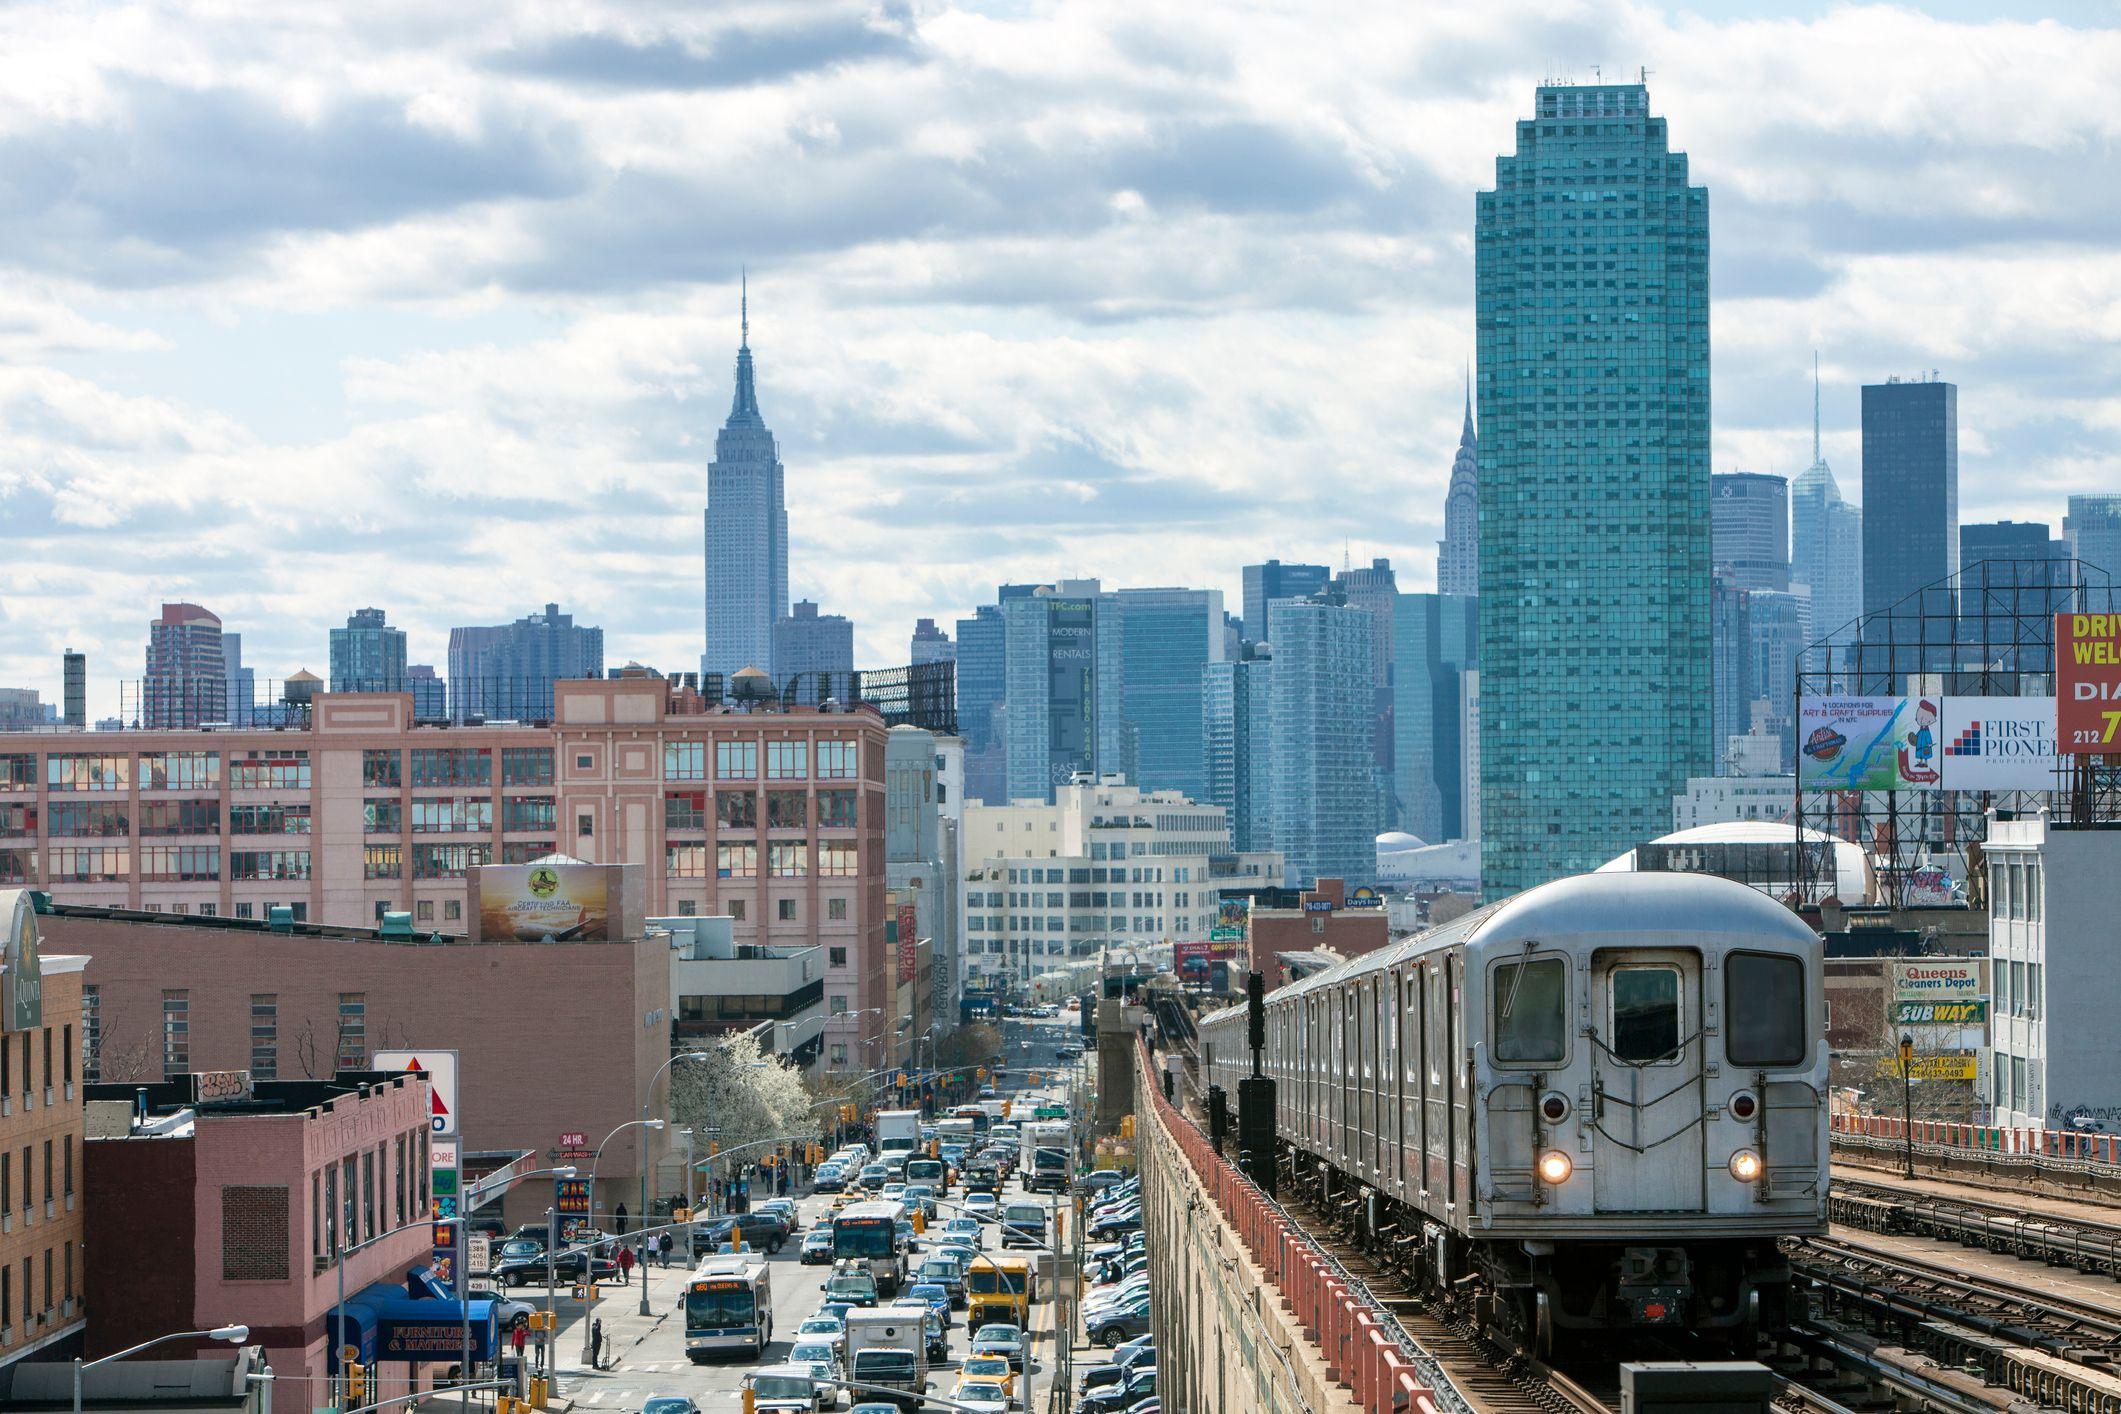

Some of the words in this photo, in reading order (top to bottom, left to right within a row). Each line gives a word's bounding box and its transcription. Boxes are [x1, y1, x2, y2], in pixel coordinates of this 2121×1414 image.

[1052, 627, 1091, 636] MODERN
[2073, 615, 2121, 637] DRI
[1052, 649, 1091, 659] RENTALS
[2073, 642, 2121, 664] WEL
[1803, 709, 1819, 717] ART
[1829, 709, 1855, 717] CRAFT
[1856, 709, 1894, 717] SUPPLIES
[1984, 720, 2046, 738] FIRST
[2073, 730, 2099, 744] 212
[1052, 763, 1079, 773] EAST
[1906, 967, 1967, 979] Queens
[1899, 979, 1941, 988] Cleaners
[1945, 979, 1975, 989] Depot
[1900, 1004, 1976, 1021] SUBWAY
[562, 1135, 571, 1145] 24
[563, 1182, 585, 1195] CAR
[560, 1197, 589, 1211] WASH
[388, 1340, 400, 1350] &
[405, 1339, 477, 1351] MATTRES
